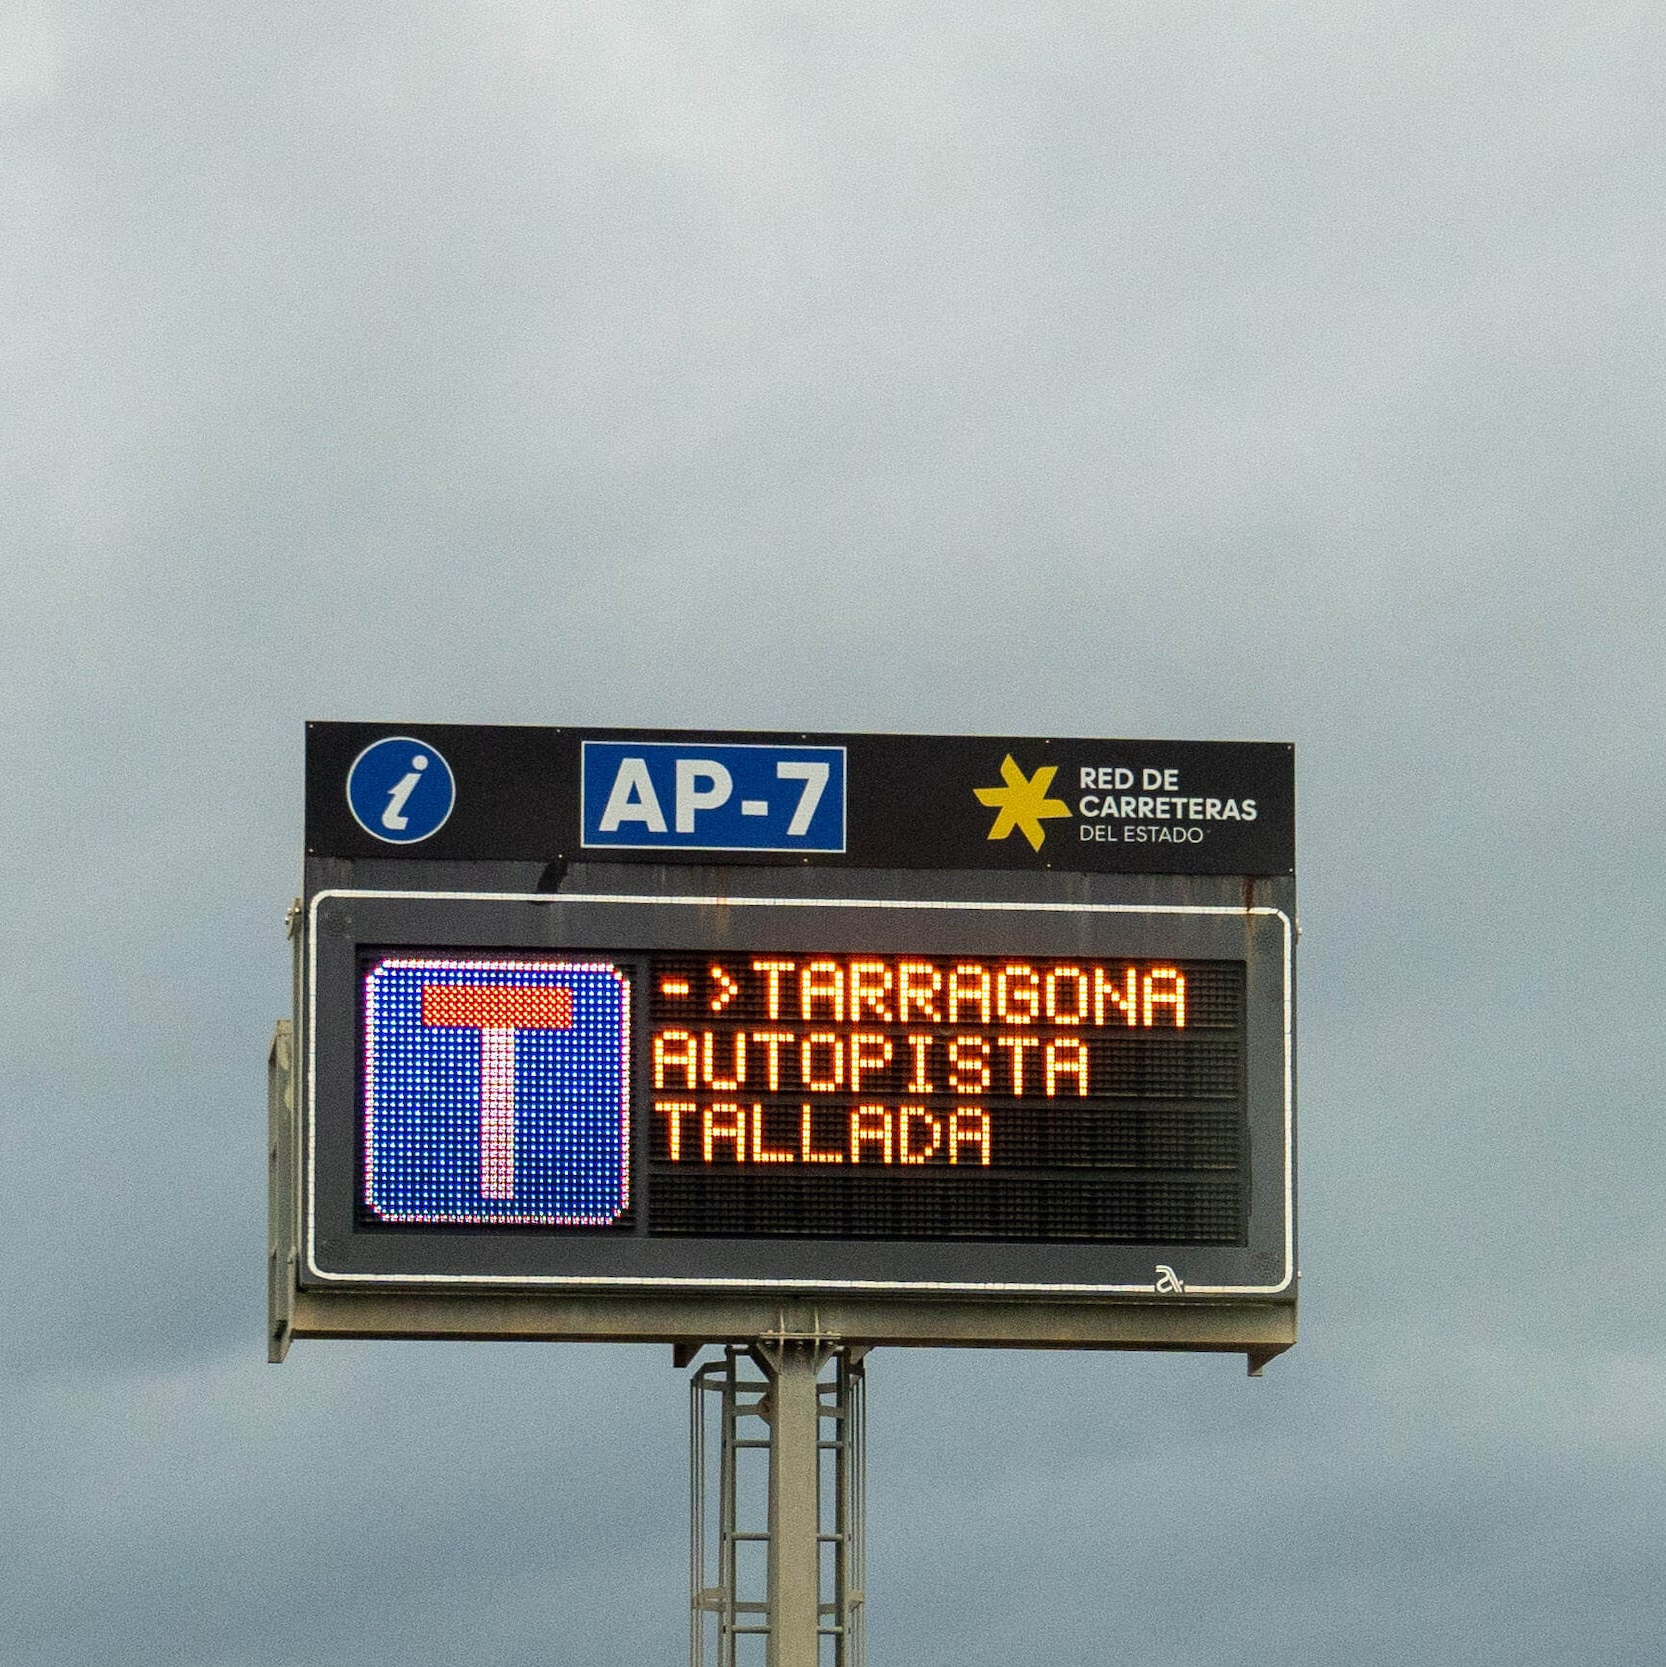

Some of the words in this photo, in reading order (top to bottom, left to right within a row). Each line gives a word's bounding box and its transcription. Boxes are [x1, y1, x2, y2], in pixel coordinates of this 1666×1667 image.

[598, 757, 830, 836] AP-7
[1080, 767, 1134, 789] RED
[1142, 768, 1180, 791] DE
[1079, 796, 1258, 821] CARRETERAS
[1079, 825, 1118, 842] DEL
[1123, 825, 1205, 844] ESTADO
[654, 1031, 1089, 1097] AUTOPISTA
[654, 1101, 992, 1166] TALLADA
